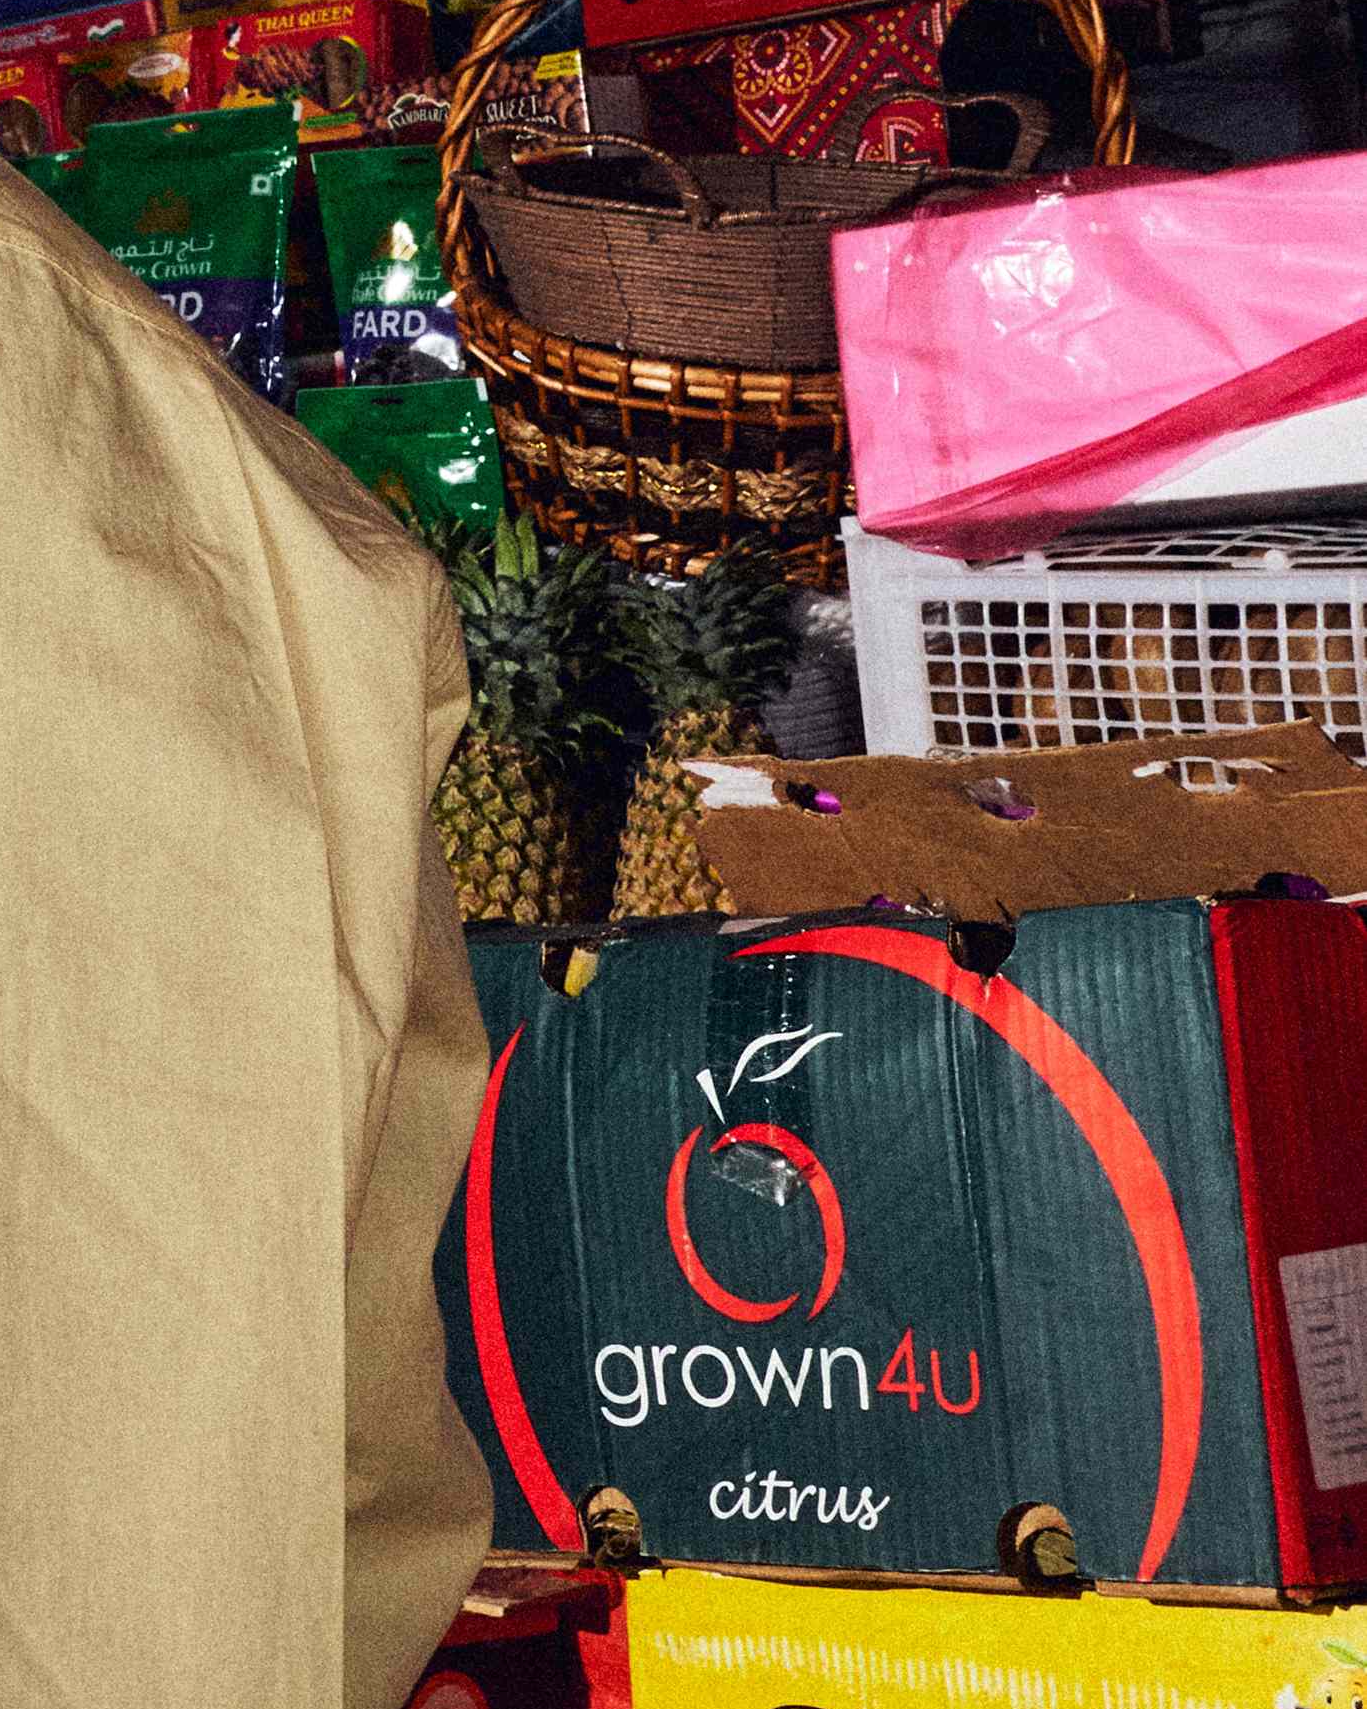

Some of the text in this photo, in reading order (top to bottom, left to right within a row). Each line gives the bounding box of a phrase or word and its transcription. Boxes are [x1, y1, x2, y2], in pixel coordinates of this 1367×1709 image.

[255, 5, 355, 34] THAI QUEEN
[486, 95, 538, 124] SWEET
[151, 260, 212, 280] Crown
[353, 309, 427, 339] FARD
[709, 1469, 891, 1531] citrus
